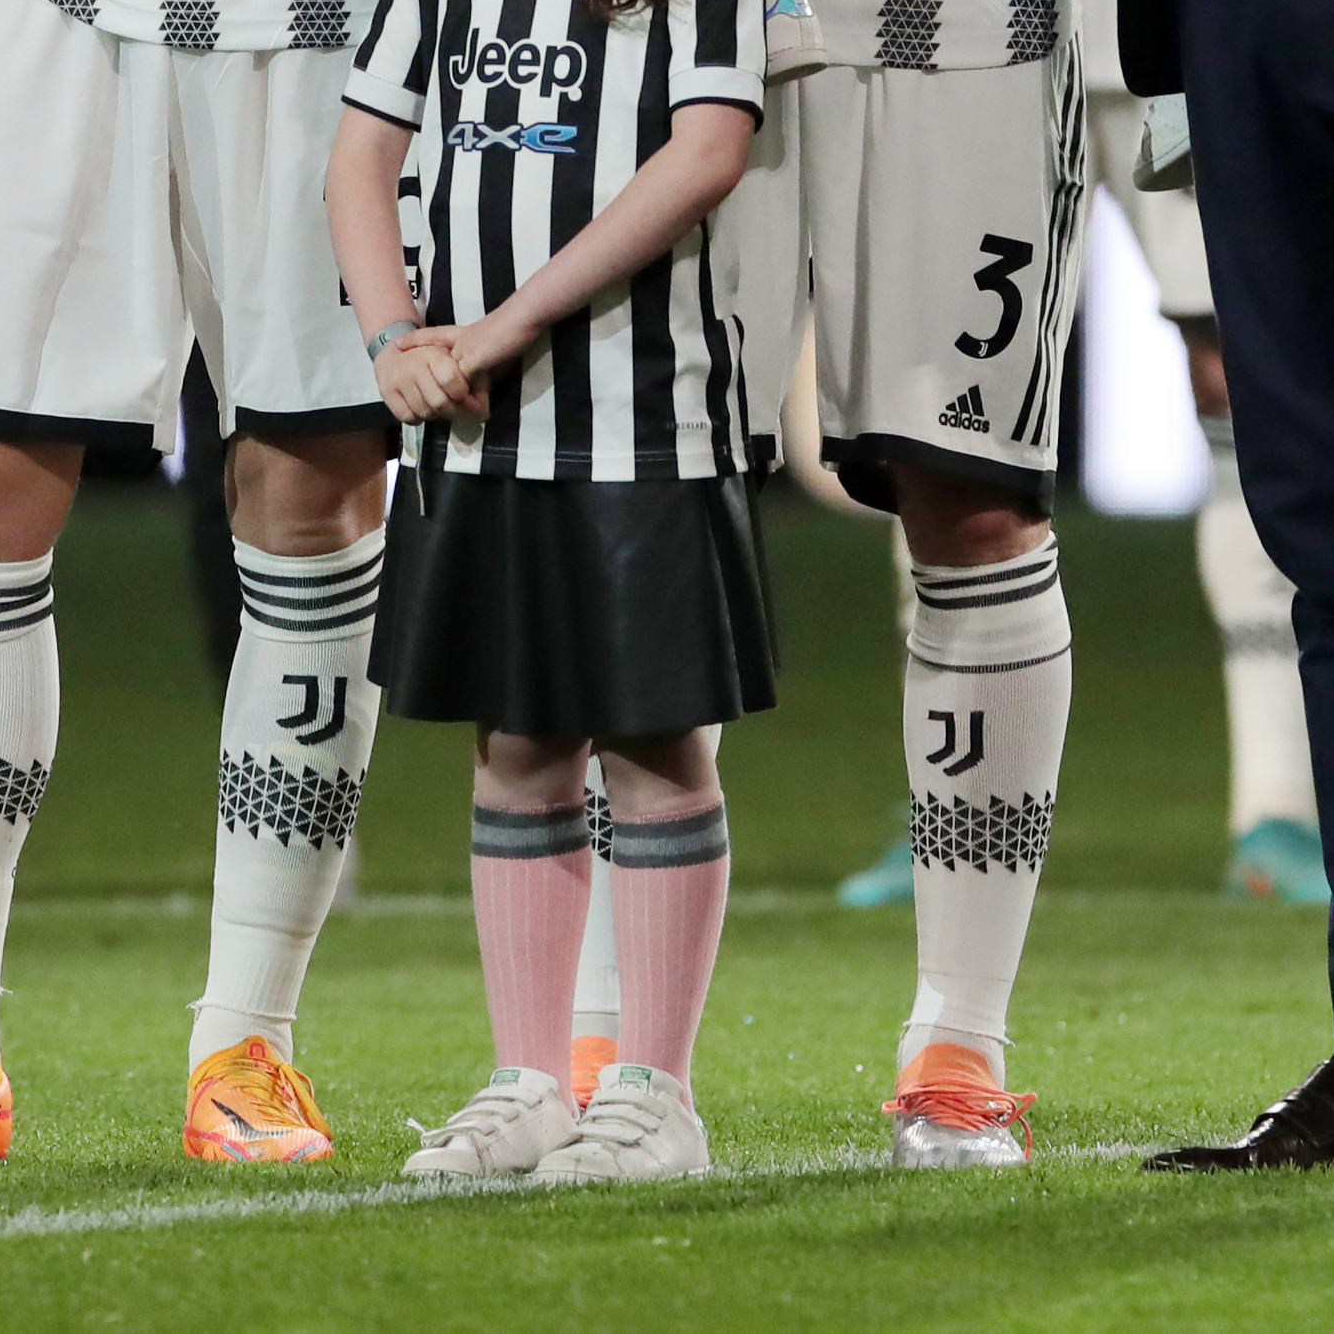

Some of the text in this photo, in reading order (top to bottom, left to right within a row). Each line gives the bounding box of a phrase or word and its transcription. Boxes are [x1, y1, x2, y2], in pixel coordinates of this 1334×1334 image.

[451, 27, 584, 98] Jeep
[954, 233, 1034, 360] 3
[938, 411, 991, 434] adidas
